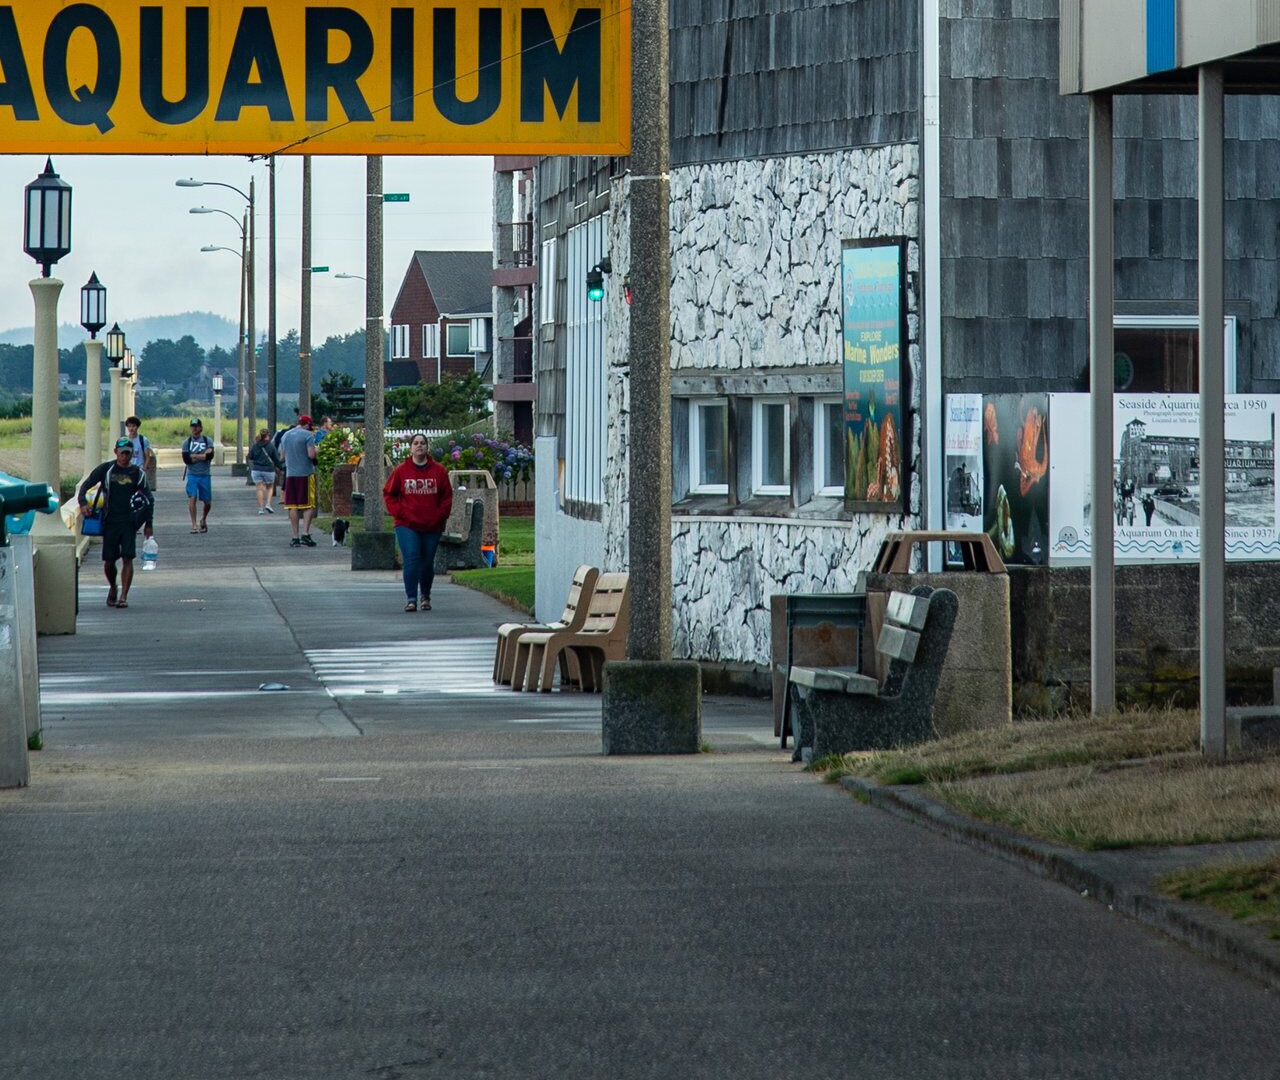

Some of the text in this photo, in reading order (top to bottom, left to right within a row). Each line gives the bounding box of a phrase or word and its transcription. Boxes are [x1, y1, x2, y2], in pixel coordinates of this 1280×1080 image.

[844, 340, 899, 365] Marine Wonders
[1118, 398, 1157, 410] Seaside
[1158, 398, 1200, 413] Aquariu
[1243, 399, 1267, 410] 1950
[1119, 528, 1162, 540] Aquarium
[1164, 528, 1178, 538] On
[1180, 528, 1193, 538] the
[1225, 528, 1276, 539] Since 1937!
